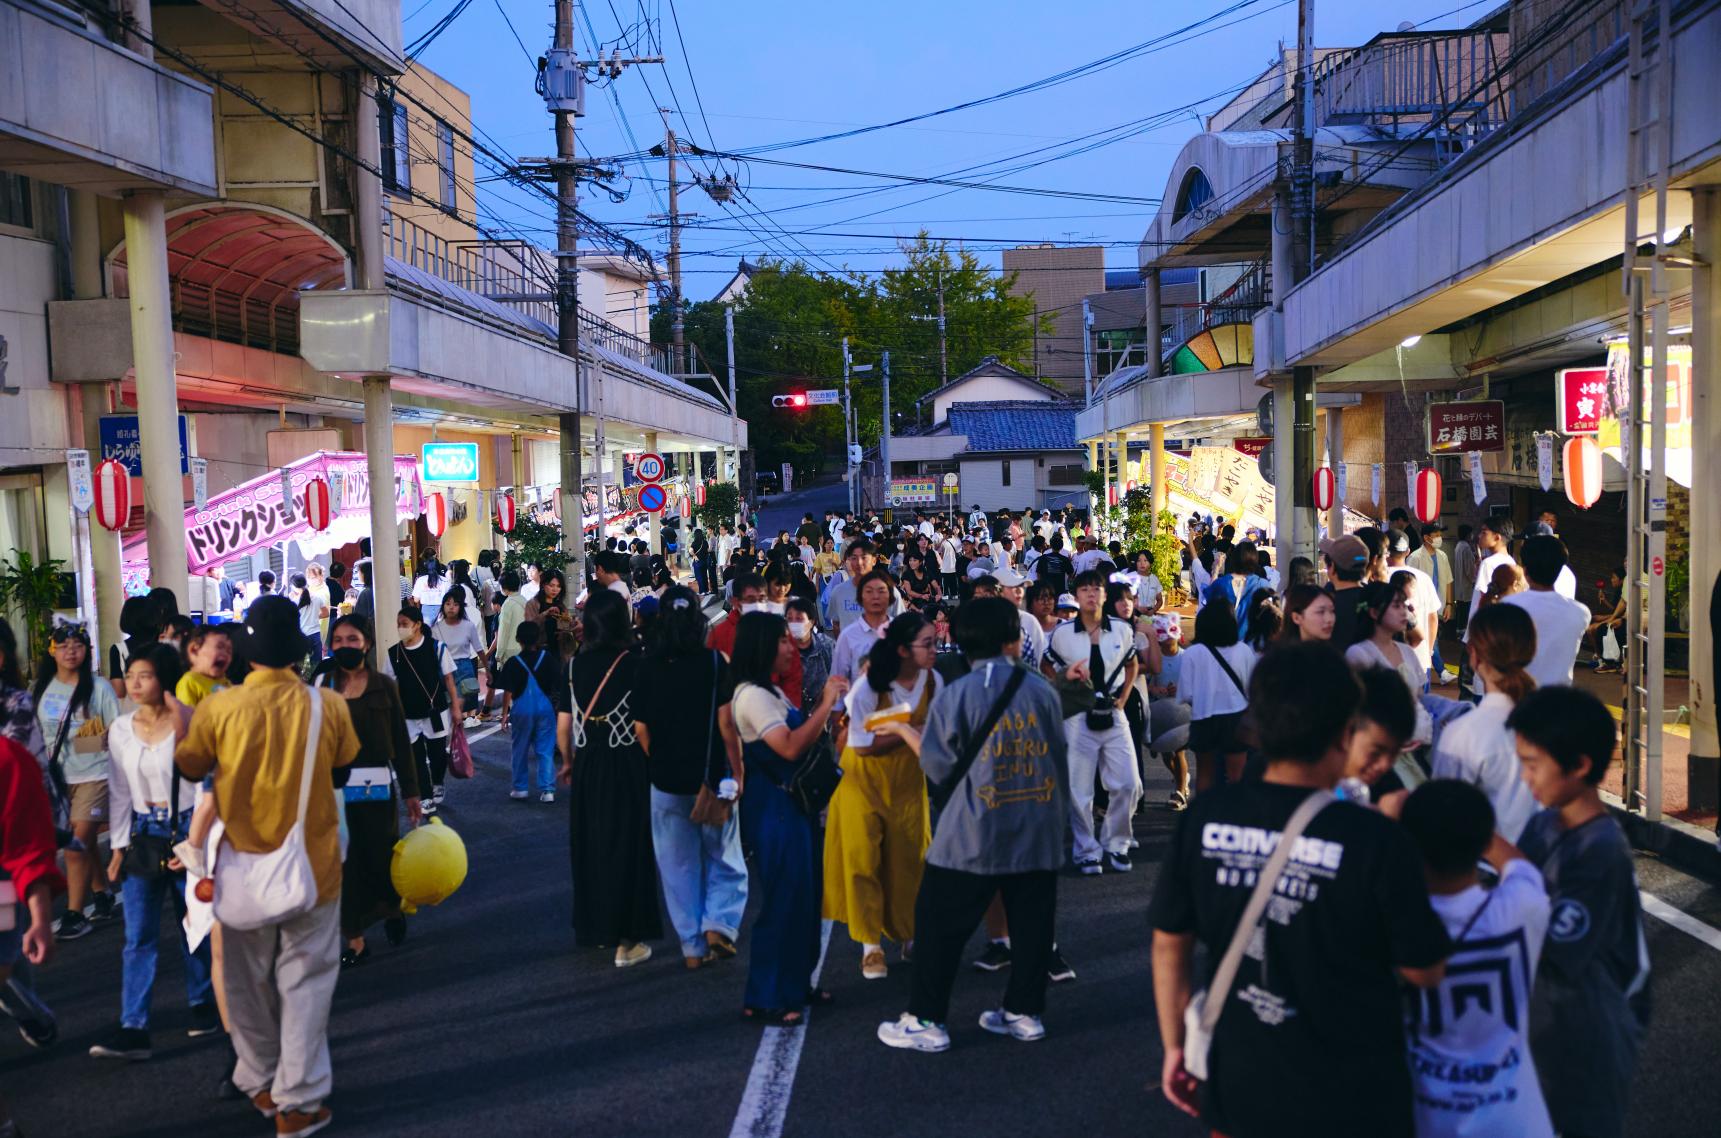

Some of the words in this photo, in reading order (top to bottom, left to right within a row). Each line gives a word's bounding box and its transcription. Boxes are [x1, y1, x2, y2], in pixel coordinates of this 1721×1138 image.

[1442, 412, 1494, 423] 花と緑のデパート
[1436, 424, 1498, 443] 石橋園芸
[642, 461, 658, 475] 40
[1222, 457, 1249, 497] たこやき
[195, 495, 252, 525] Drink
[254, 472, 308, 500] Shp
[188, 492, 307, 562] ドリンクショッ
[844, 599, 864, 611] Ear
[1202, 822, 1344, 871] CONVRSE
